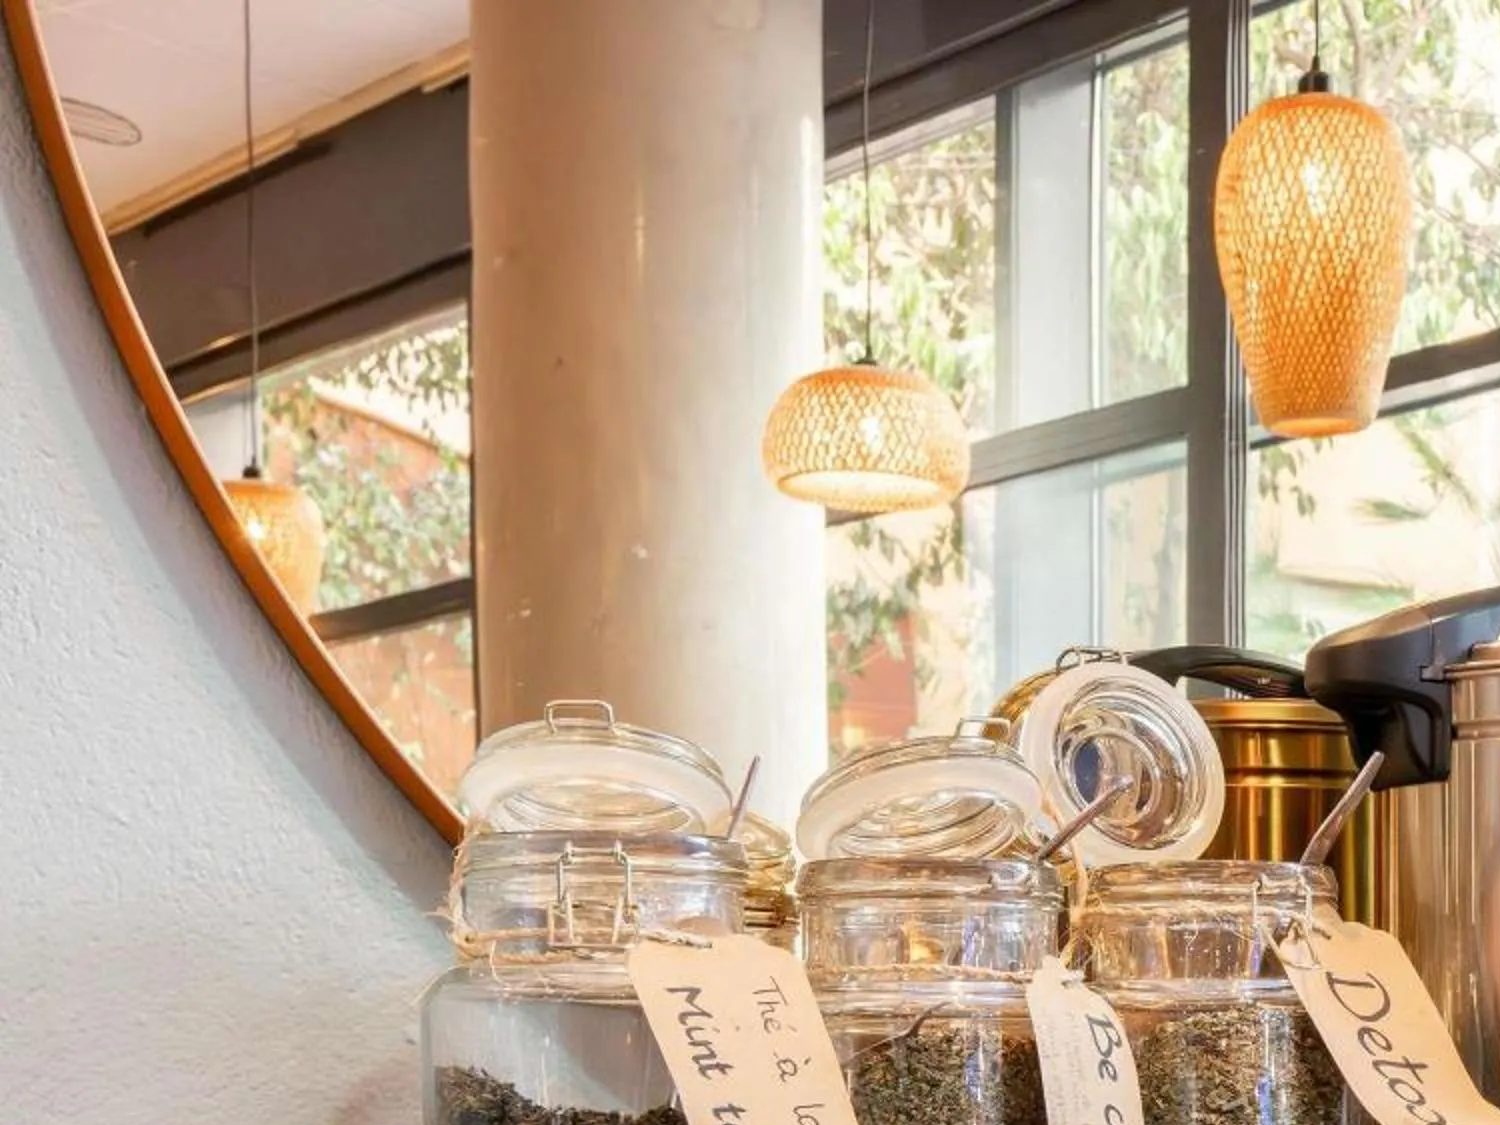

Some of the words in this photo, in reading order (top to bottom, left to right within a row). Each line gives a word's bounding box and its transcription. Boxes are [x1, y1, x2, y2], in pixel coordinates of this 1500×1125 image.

[664, 986, 740, 1081] Mint
[752, 975, 798, 1035] Thé
[1085, 1013, 1123, 1083] Be
